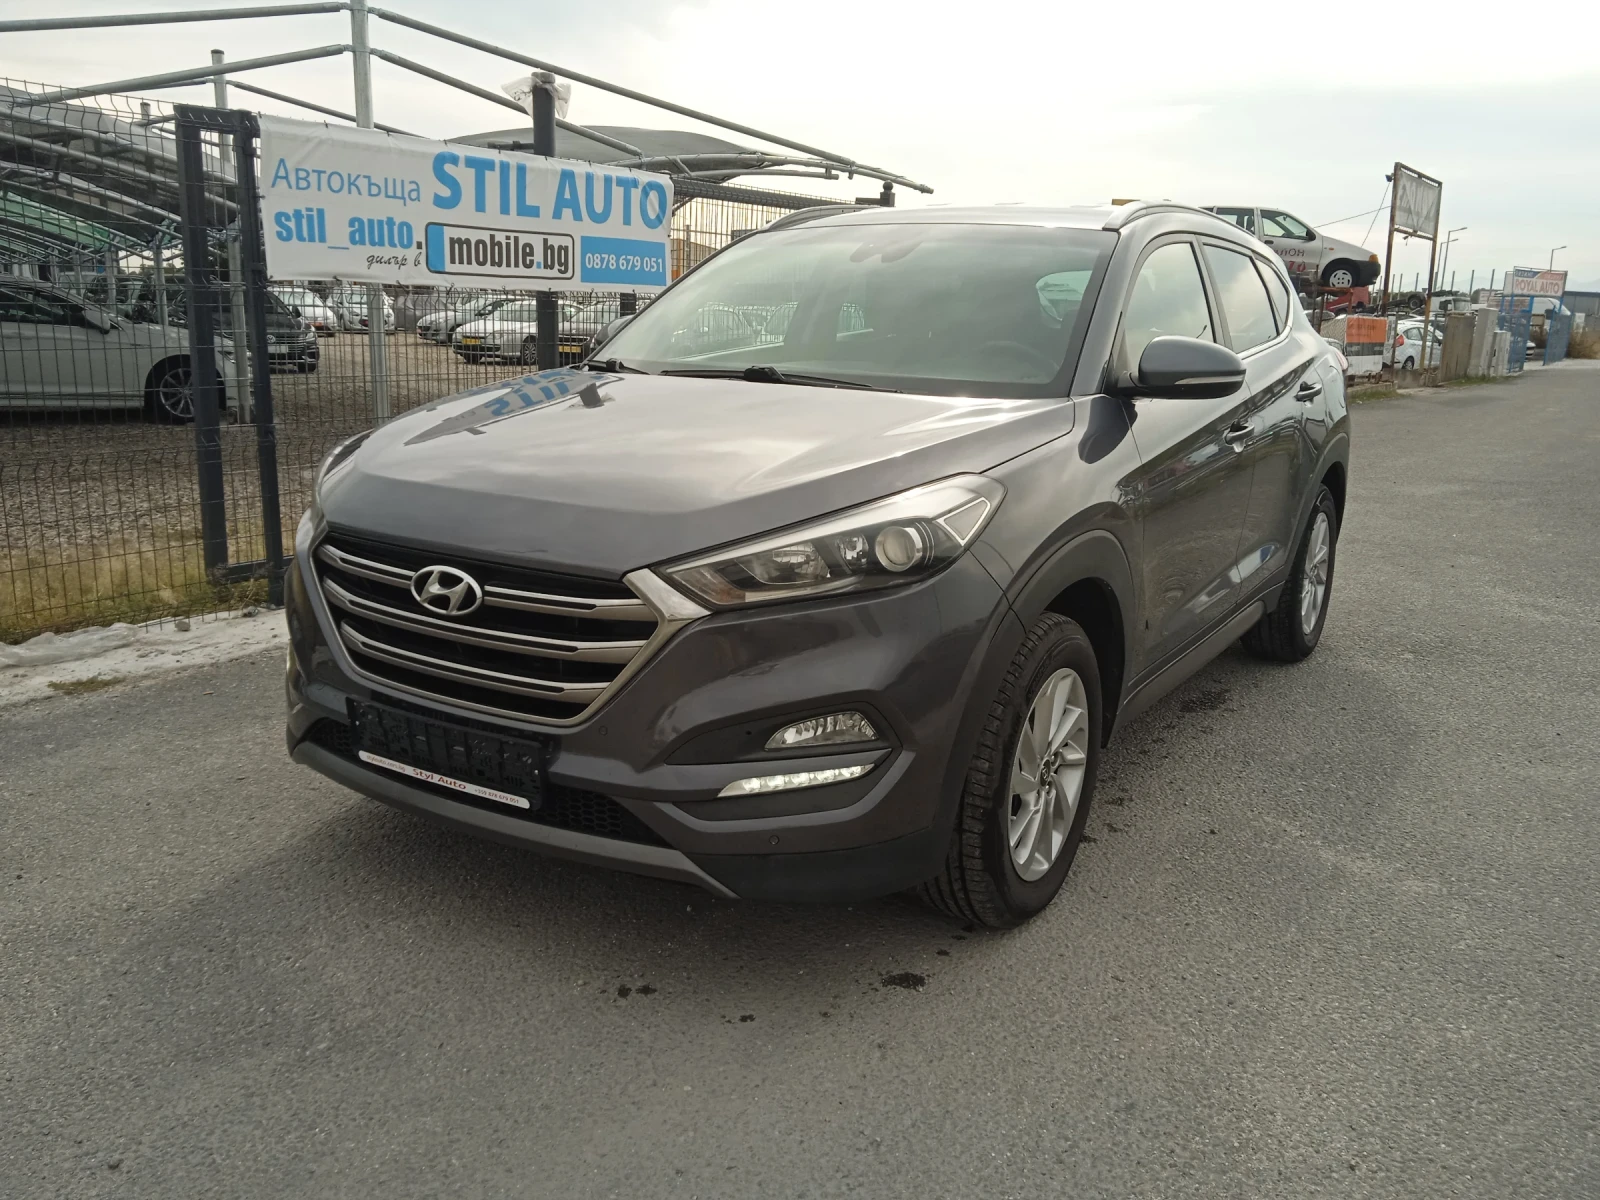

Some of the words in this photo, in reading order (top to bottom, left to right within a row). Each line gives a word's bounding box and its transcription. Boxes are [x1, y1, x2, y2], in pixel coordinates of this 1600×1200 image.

[271, 158, 421, 206] Автокъща
[432, 151, 540, 218] STIL
[552, 168, 667, 229] AUTO
[367, 253, 408, 270] дилър
[449, 234, 569, 274] mobile.bg
[585, 253, 616, 269] 0878
[619, 255, 641, 271] 679
[643, 257, 663, 273] 051
[1515, 279, 1538, 292] ROYAL
[1539, 281, 1560, 294] AUTO
[412, 768, 434, 780] Styl
[437, 776, 466, 790] Auto
